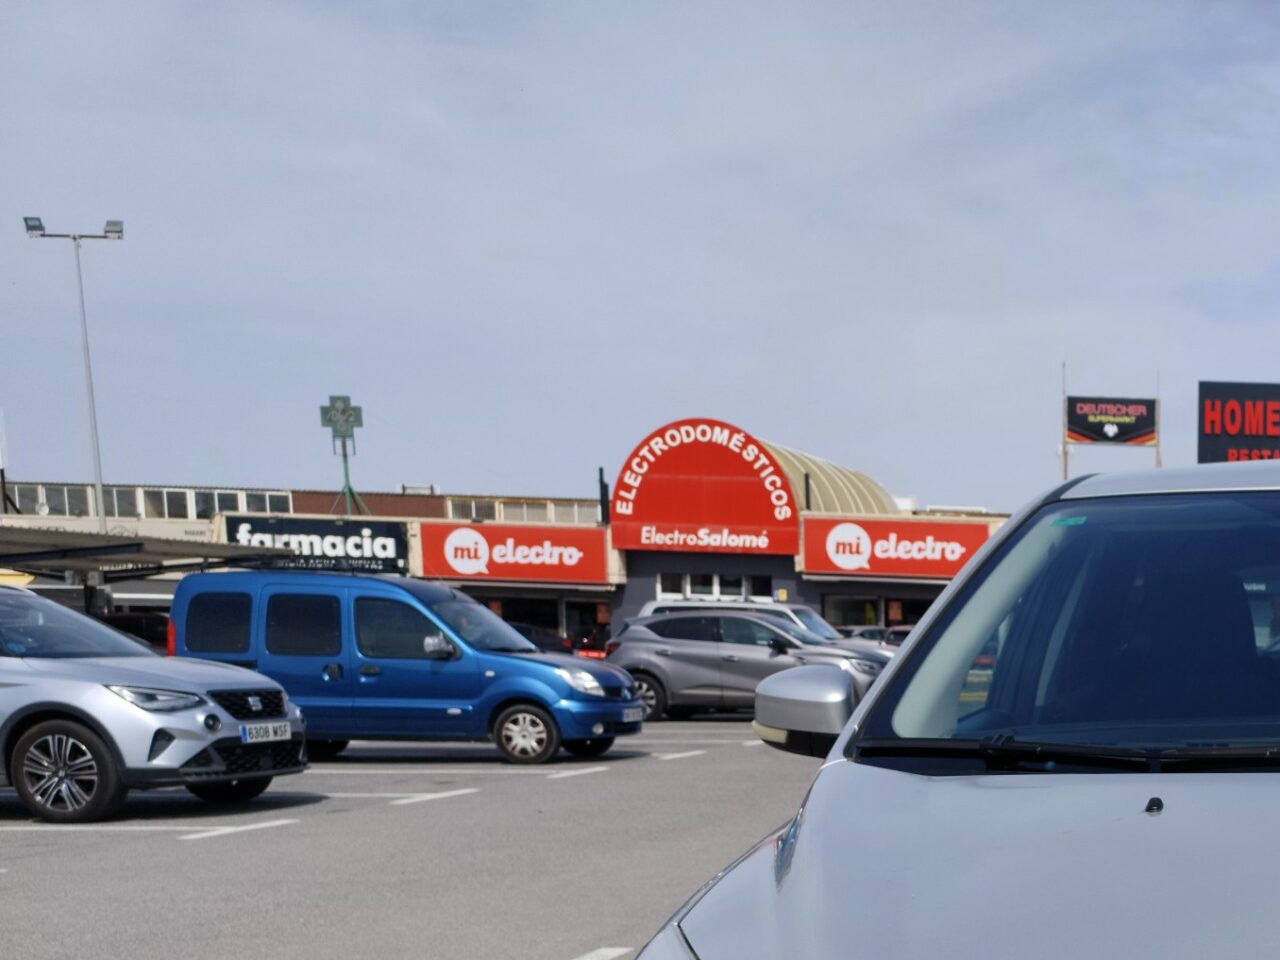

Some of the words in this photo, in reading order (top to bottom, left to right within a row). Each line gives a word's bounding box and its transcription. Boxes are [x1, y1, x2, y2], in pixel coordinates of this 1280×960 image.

[1204, 400, 1280, 437] HOME
[616, 424, 792, 520] ELECTRODOMÉSTICOS
[236, 523, 396, 558] farmacia
[454, 541, 480, 561] mi
[492, 539, 583, 565] electro
[640, 526, 769, 548] ElectroSalomé
[836, 540, 863, 555] mi
[874, 533, 966, 560] electro
